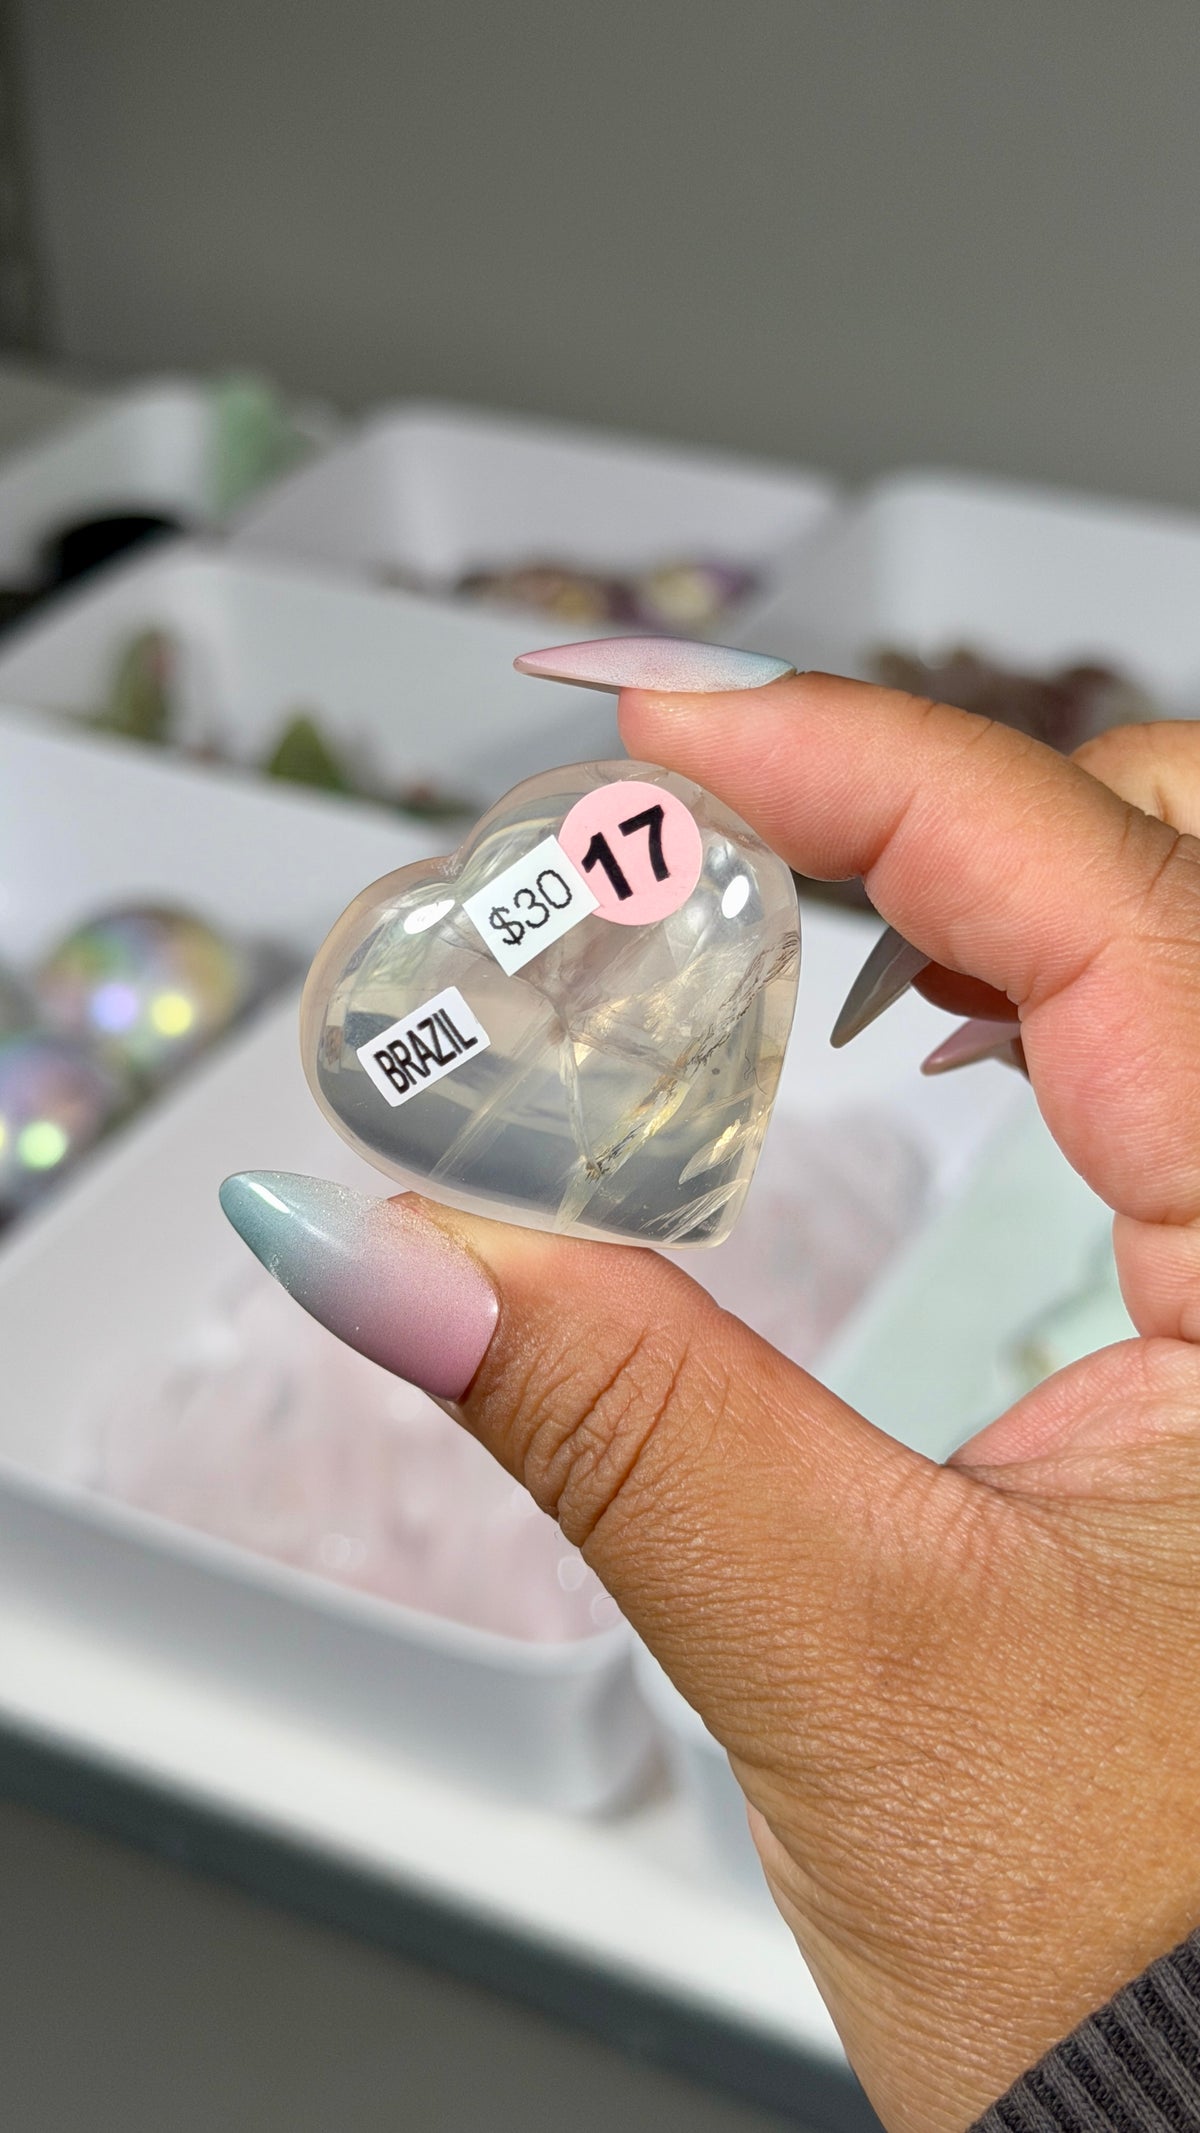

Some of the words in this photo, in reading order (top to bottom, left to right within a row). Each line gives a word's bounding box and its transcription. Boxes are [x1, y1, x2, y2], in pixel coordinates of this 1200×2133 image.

[581, 804, 669, 901] 17
[489, 869, 573, 946] $30
[373, 1008, 478, 1094] BRAZIL
